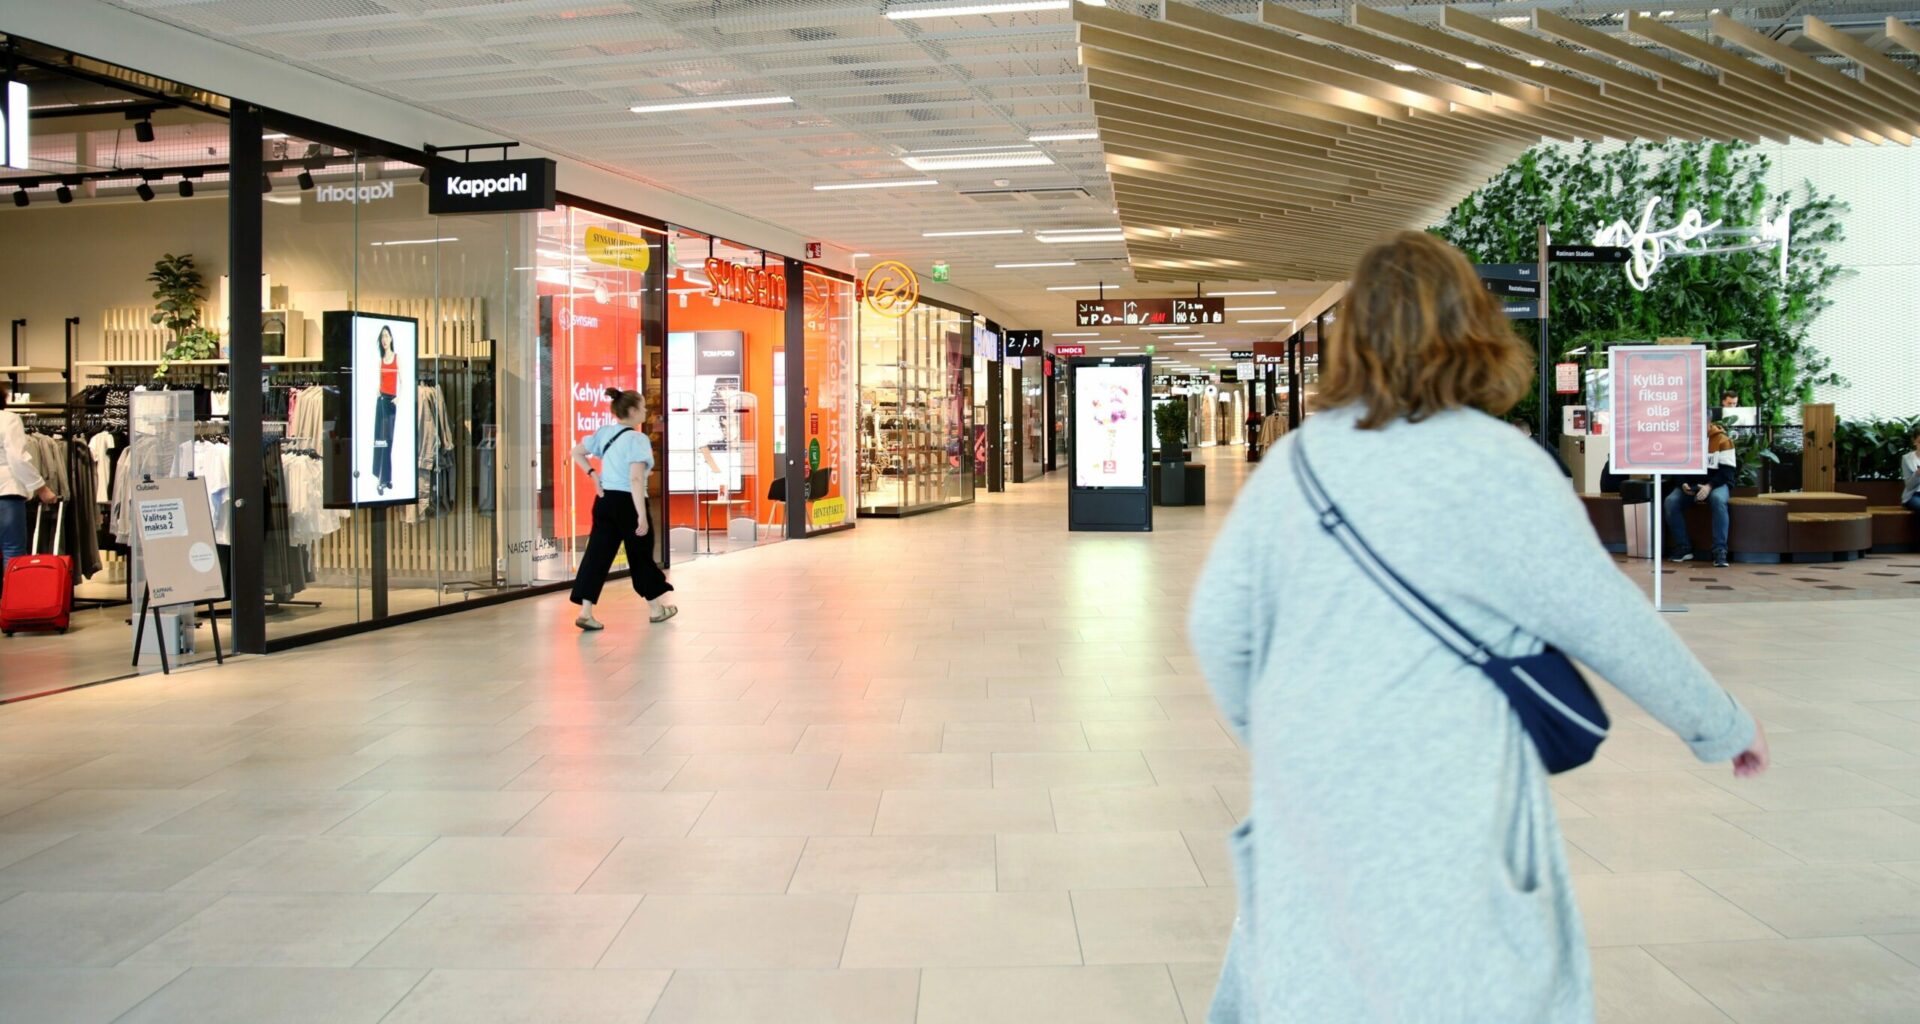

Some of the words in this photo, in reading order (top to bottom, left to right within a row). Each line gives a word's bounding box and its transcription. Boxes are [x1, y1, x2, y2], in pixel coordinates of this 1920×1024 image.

[446, 172, 528, 198] Kappahl
[1633, 373, 1664, 388] Kyllä
[1667, 375, 1683, 386] on
[1638, 389, 1678, 401] fiksua
[1647, 405, 1670, 417] olla
[1637, 420, 1680, 432] kantis!
[830, 419, 838, 485] HAND
[143, 514, 167, 522] Valitse
[168, 512, 173, 520] 3
[144, 523, 168, 531] maksa
[169, 521, 174, 529] 2
[508, 541, 532, 554] NAISET
